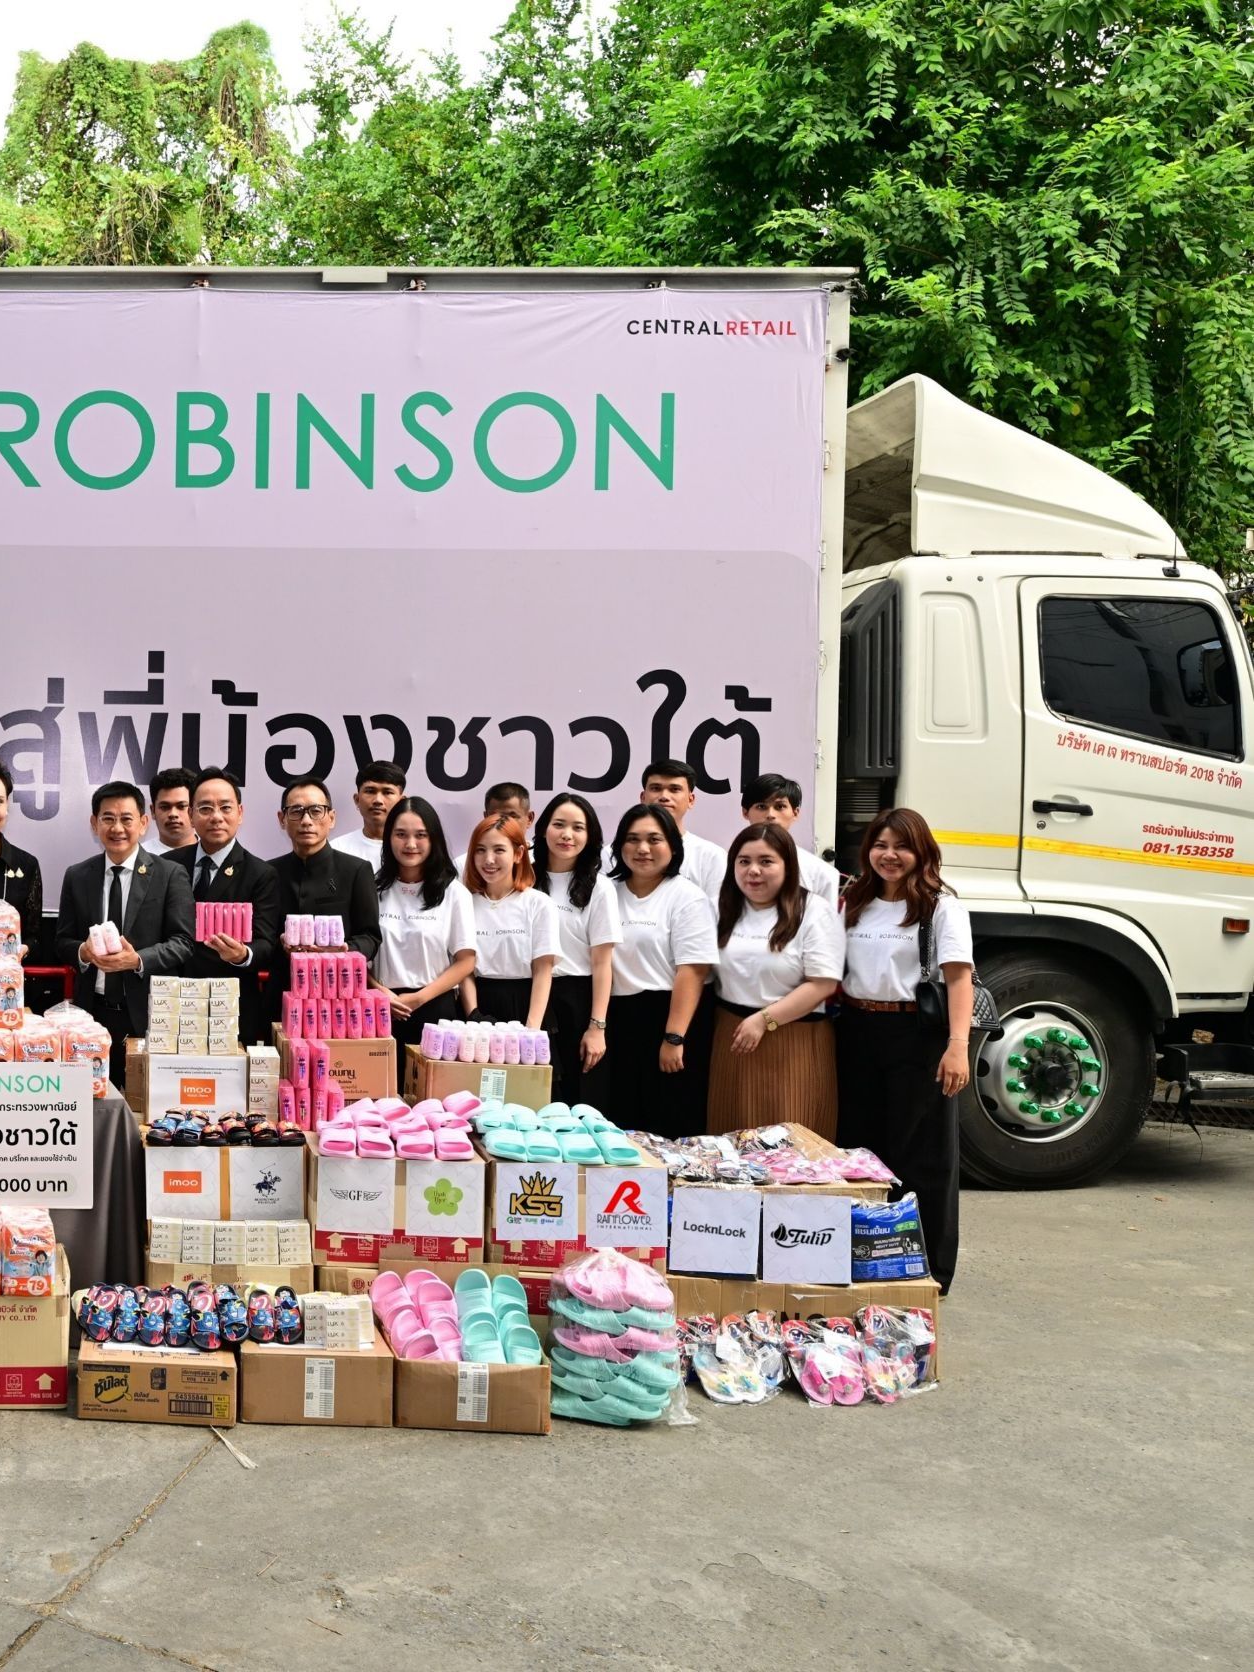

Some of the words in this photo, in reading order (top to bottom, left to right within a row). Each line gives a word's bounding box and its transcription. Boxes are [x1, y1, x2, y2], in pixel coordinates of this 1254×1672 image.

[1057, 732, 1091, 752] บริษัท
[1093, 742, 1105, 757] เค
[1107, 746, 1118, 758] เจ
[1121, 749, 1187, 776] ทรานสปอร์ต
[1190, 766, 1214, 782] 2018
[1217, 768, 1243, 789] จำกัด
[1142, 824, 1234, 844] รถรับจ้างไม่ประจำทาง
[1142, 842, 1235, 858] 081-1538358
[379, 913, 401, 921] NTRAL
[4, 1013, 17, 1021] 79
[329, 1069, 356, 1081] owny
[36, 1180, 68, 1192] บาท
[349, 1191, 362, 1200] GF
[510, 1193, 563, 1217] KSG
[597, 1214, 652, 1225] RAINFLOWER
[683, 1221, 746, 1238] LocknLock
[788, 1228, 836, 1246] Tulip
[30, 1281, 44, 1290] 79
